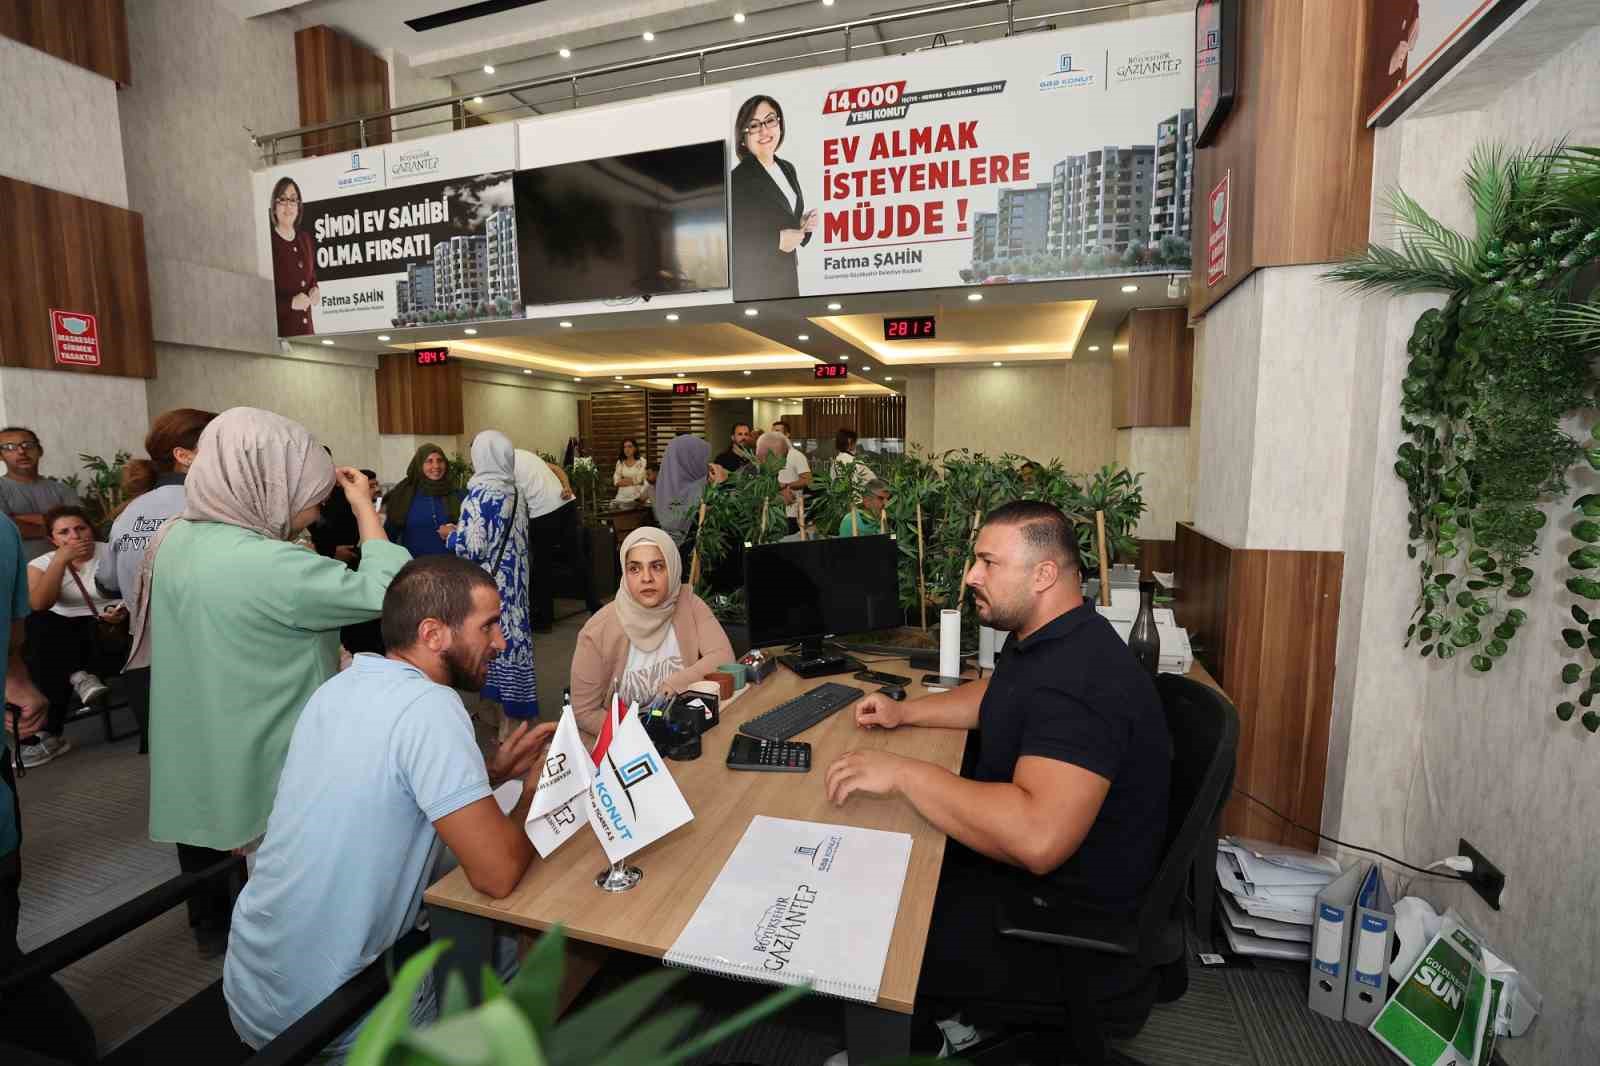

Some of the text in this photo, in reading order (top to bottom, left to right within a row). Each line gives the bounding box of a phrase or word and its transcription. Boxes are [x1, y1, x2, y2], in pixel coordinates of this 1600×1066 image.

[828, 84, 899, 112] 14.000
[874, 104, 907, 119] KONUT
[823, 120, 979, 166] EV ALMAK
[823, 151, 1031, 201] İSTEYENLERE
[314, 195, 449, 243] ŞİMDİ EV SAHİBİ
[823, 201, 944, 244] MÜJDE
[316, 233, 431, 269] OLMA FIRSATI
[824, 247, 923, 270] Fatma ŞAHİN
[321, 287, 384, 308] Fatma ŞAHİN
[595, 782, 633, 840] KONUT
[1413, 965, 1461, 1010] SUN
